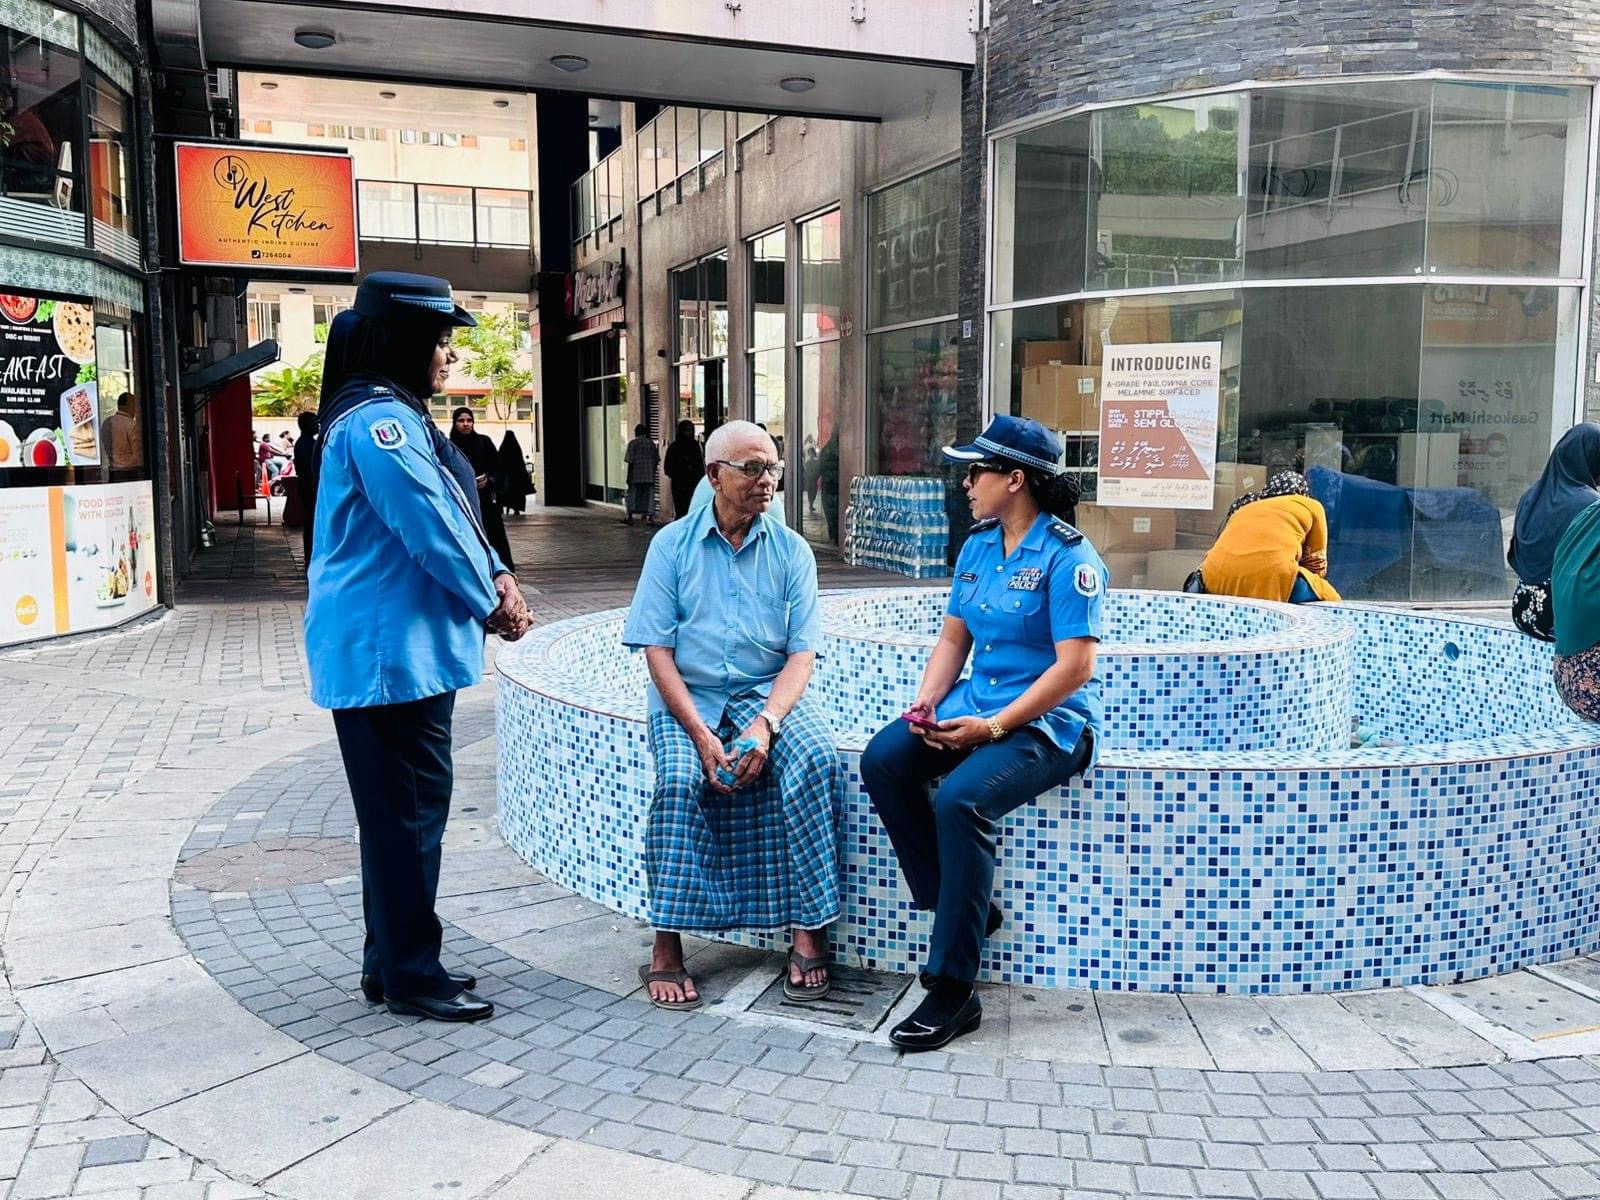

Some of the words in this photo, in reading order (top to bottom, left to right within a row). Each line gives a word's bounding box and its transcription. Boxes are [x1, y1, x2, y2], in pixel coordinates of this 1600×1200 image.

[234, 176, 295, 211] West
[247, 203, 334, 238] Kitchen
[1111, 355, 1212, 372] INTRODUCING
[1106, 380, 1140, 388] A-GRADE
[1158, 388, 1201, 396] SURFACED
[1133, 409, 1175, 419] STIPPLE
[1133, 419, 1156, 428] SEMI
[78, 498, 103, 509] FOOD
[79, 511, 102, 520] WITH
[1009, 581, 1038, 590] POLICE
